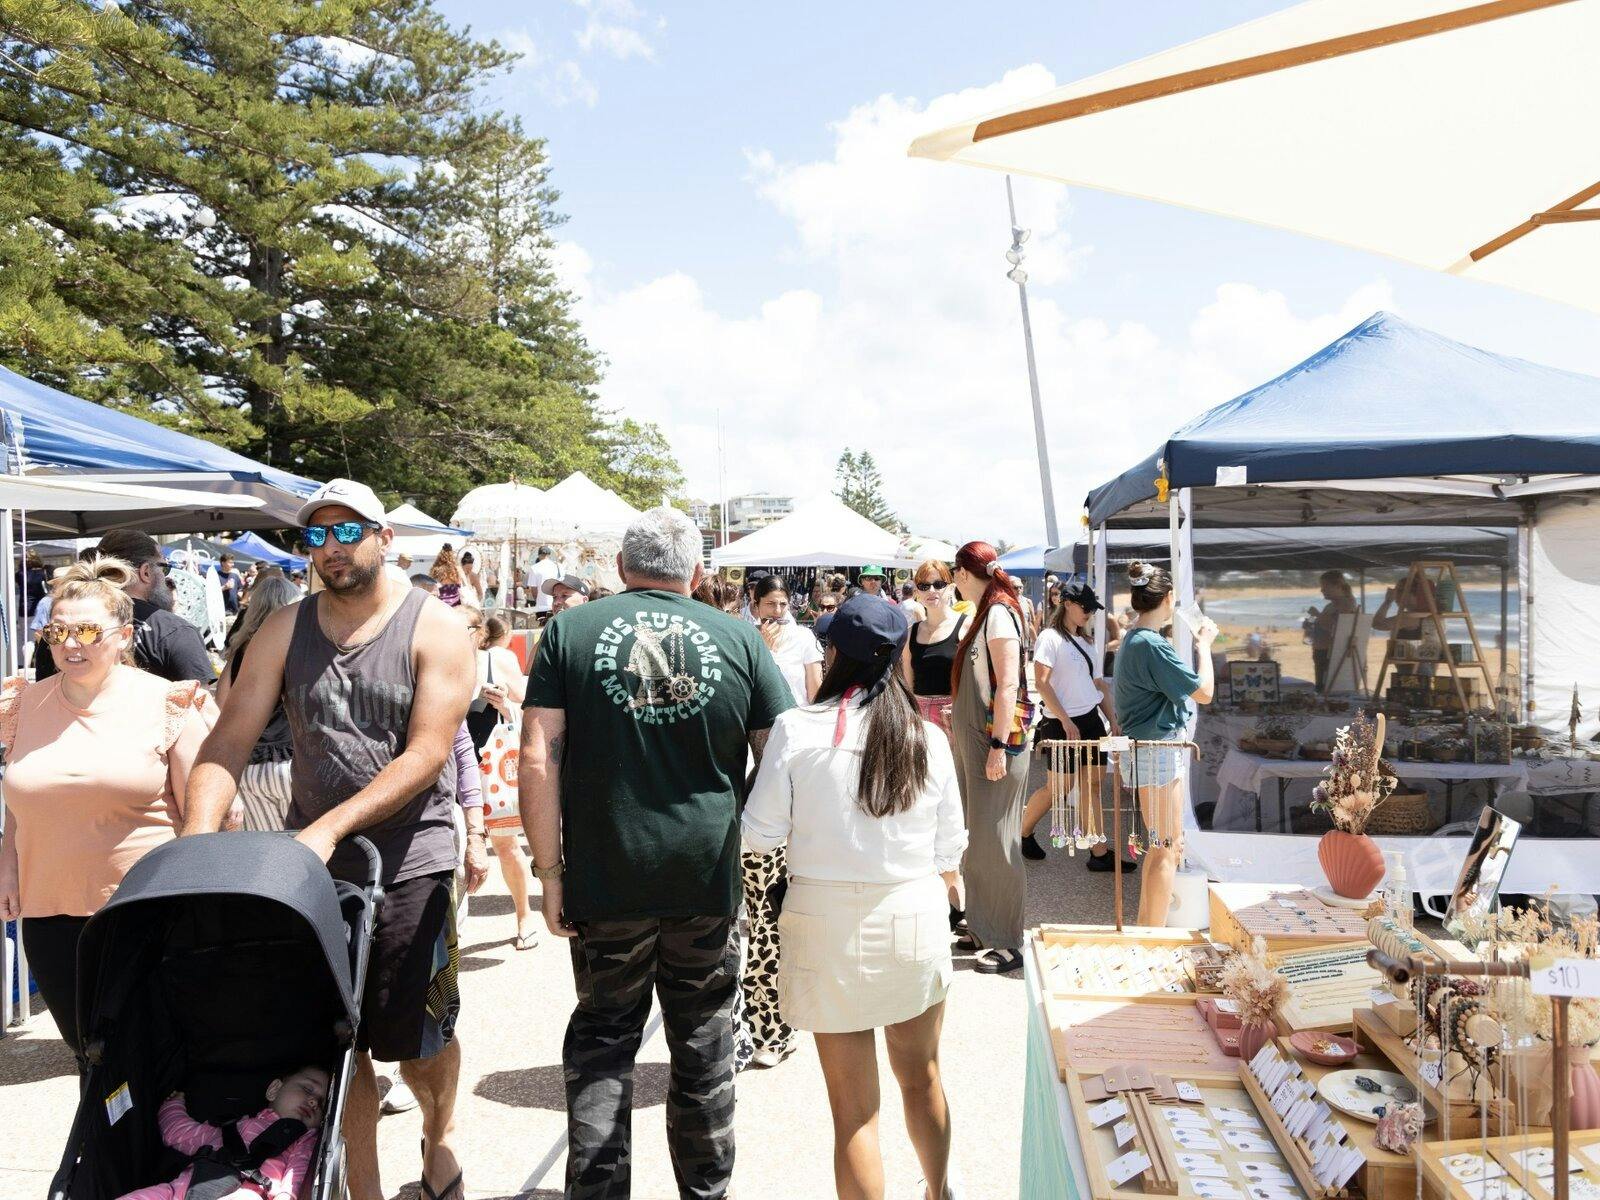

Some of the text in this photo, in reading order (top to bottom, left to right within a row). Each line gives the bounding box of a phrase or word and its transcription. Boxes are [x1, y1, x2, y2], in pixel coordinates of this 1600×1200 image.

[594, 611, 722, 682] DEUS CUSTOMS
[601, 674, 716, 725] MOTORCYCLES
